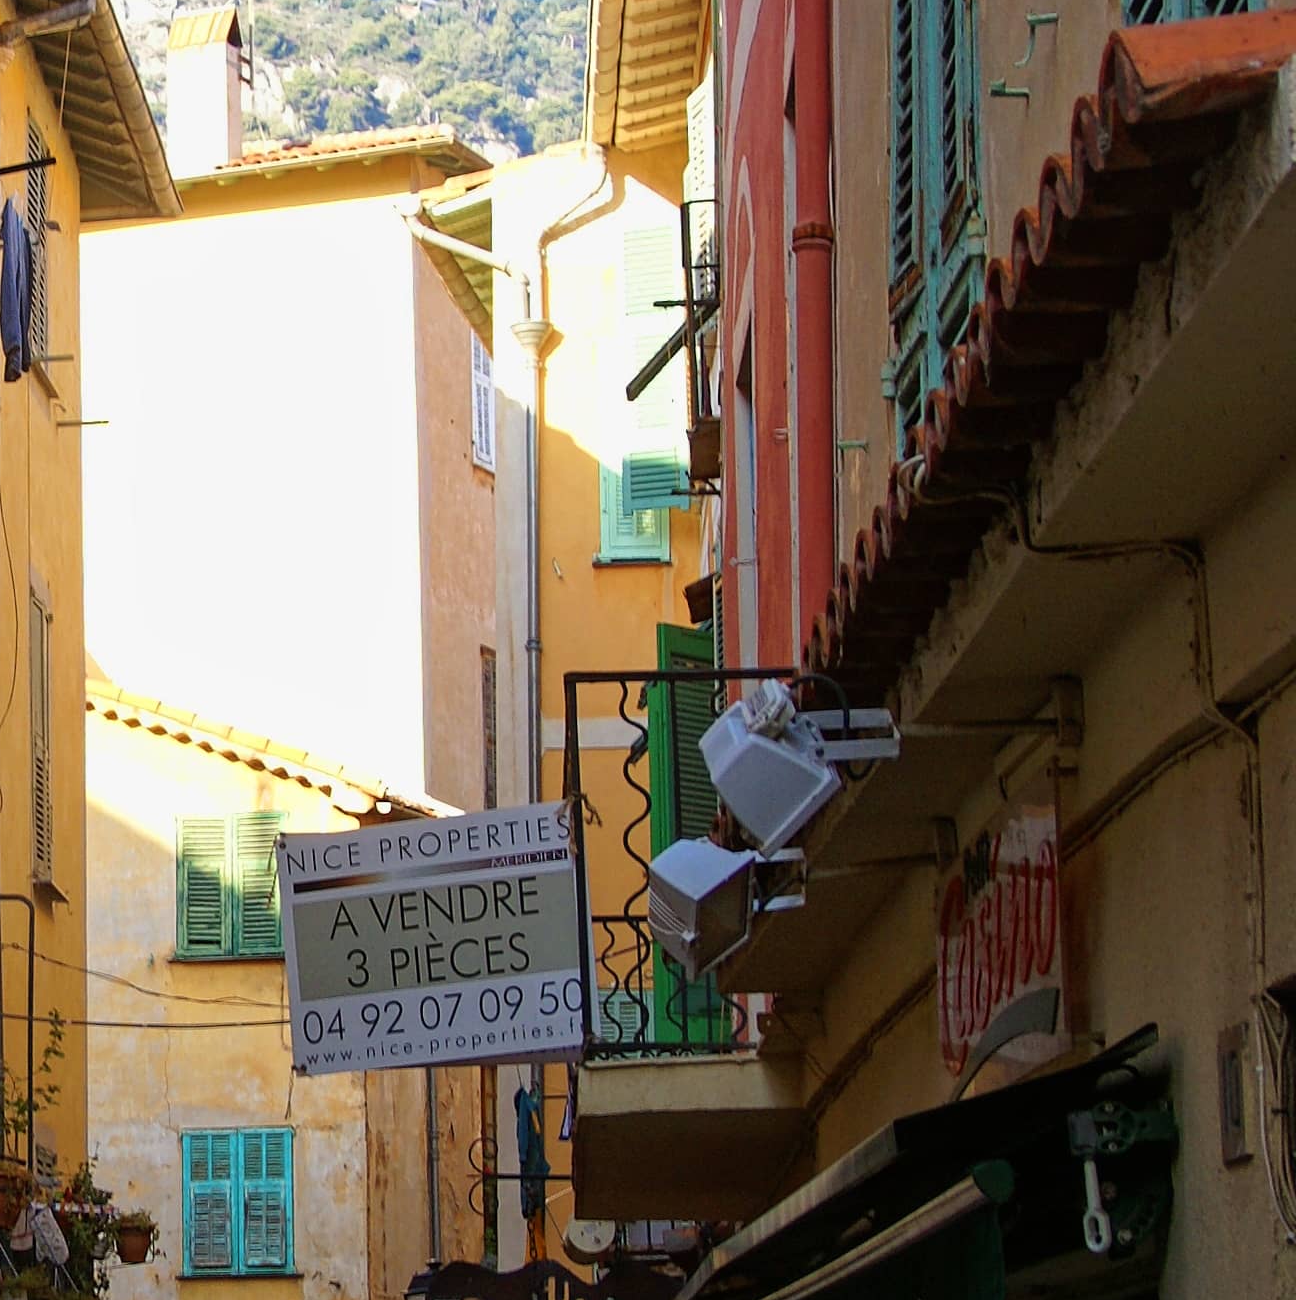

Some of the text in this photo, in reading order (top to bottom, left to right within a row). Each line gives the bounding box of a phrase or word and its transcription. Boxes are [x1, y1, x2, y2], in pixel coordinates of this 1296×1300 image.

[286, 812, 571, 875] NICE PROPERTIES
[329, 875, 540, 941] A VENDRE
[346, 932, 530, 989] 3 PIÈCES
[303, 977, 582, 1045] 04 92 07 09 50
[306, 1016, 583, 1067] www.nice-properties.f
